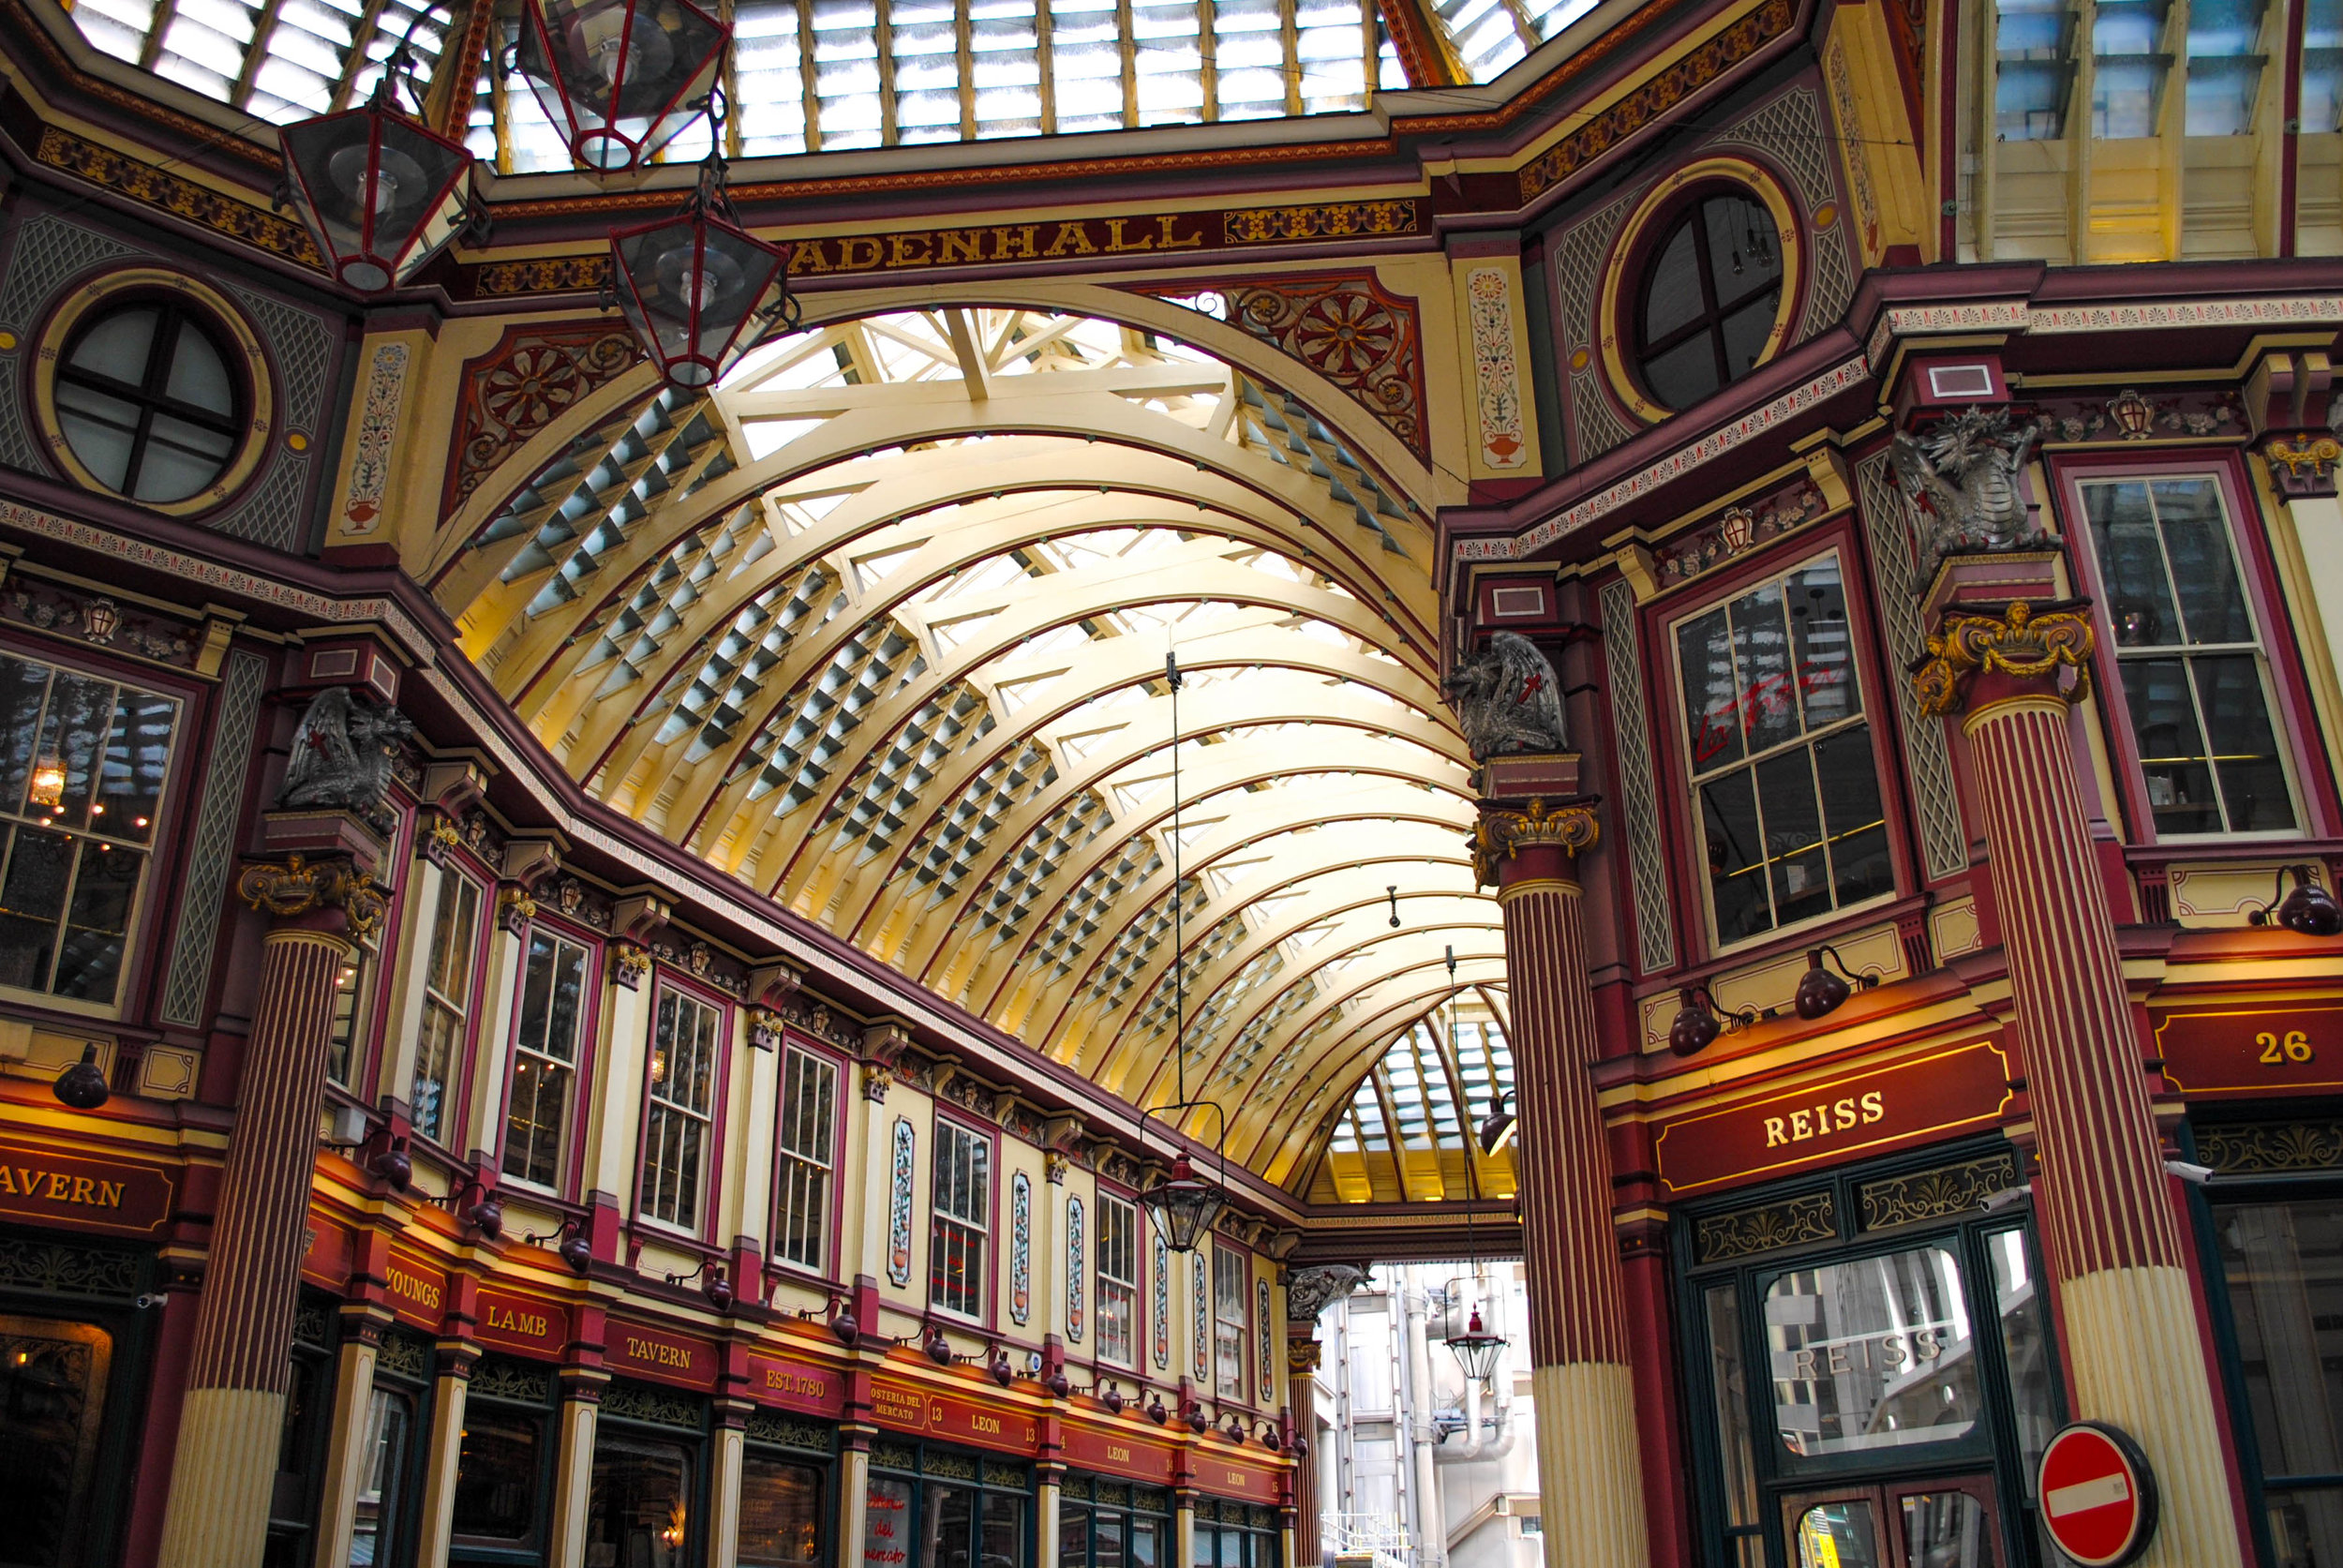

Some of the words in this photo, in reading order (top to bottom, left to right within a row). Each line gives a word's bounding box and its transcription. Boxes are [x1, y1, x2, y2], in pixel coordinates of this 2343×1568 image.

[787, 216, 1201, 274] ADENHALL
[2256, 1030, 2312, 1064] 26
[1764, 1091, 1885, 1148] REISS
[0, 1165, 126, 1208] AVERN
[385, 1266, 440, 1309] YOUNGS
[486, 1306, 547, 1337] LAMB
[626, 1337, 693, 1369] TAVERN
[1794, 1330, 1943, 1380] REISS
[766, 1369, 795, 1393] EST.
[797, 1376, 826, 1398] 1780
[876, 1403, 915, 1421] MERCATO
[906, 1396, 921, 1409] DEL
[932, 1407, 943, 1422] 13
[972, 1414, 1000, 1434] LEON
[1025, 1427, 1036, 1442] 13
[1060, 1435, 1067, 1449] 4
[1107, 1445, 1130, 1462] LEON
[1166, 1458, 1174, 1472] 14
[1192, 1464, 1198, 1475] 5
[1227, 1471, 1246, 1486] LEON
[1272, 1481, 1279, 1493] 15
